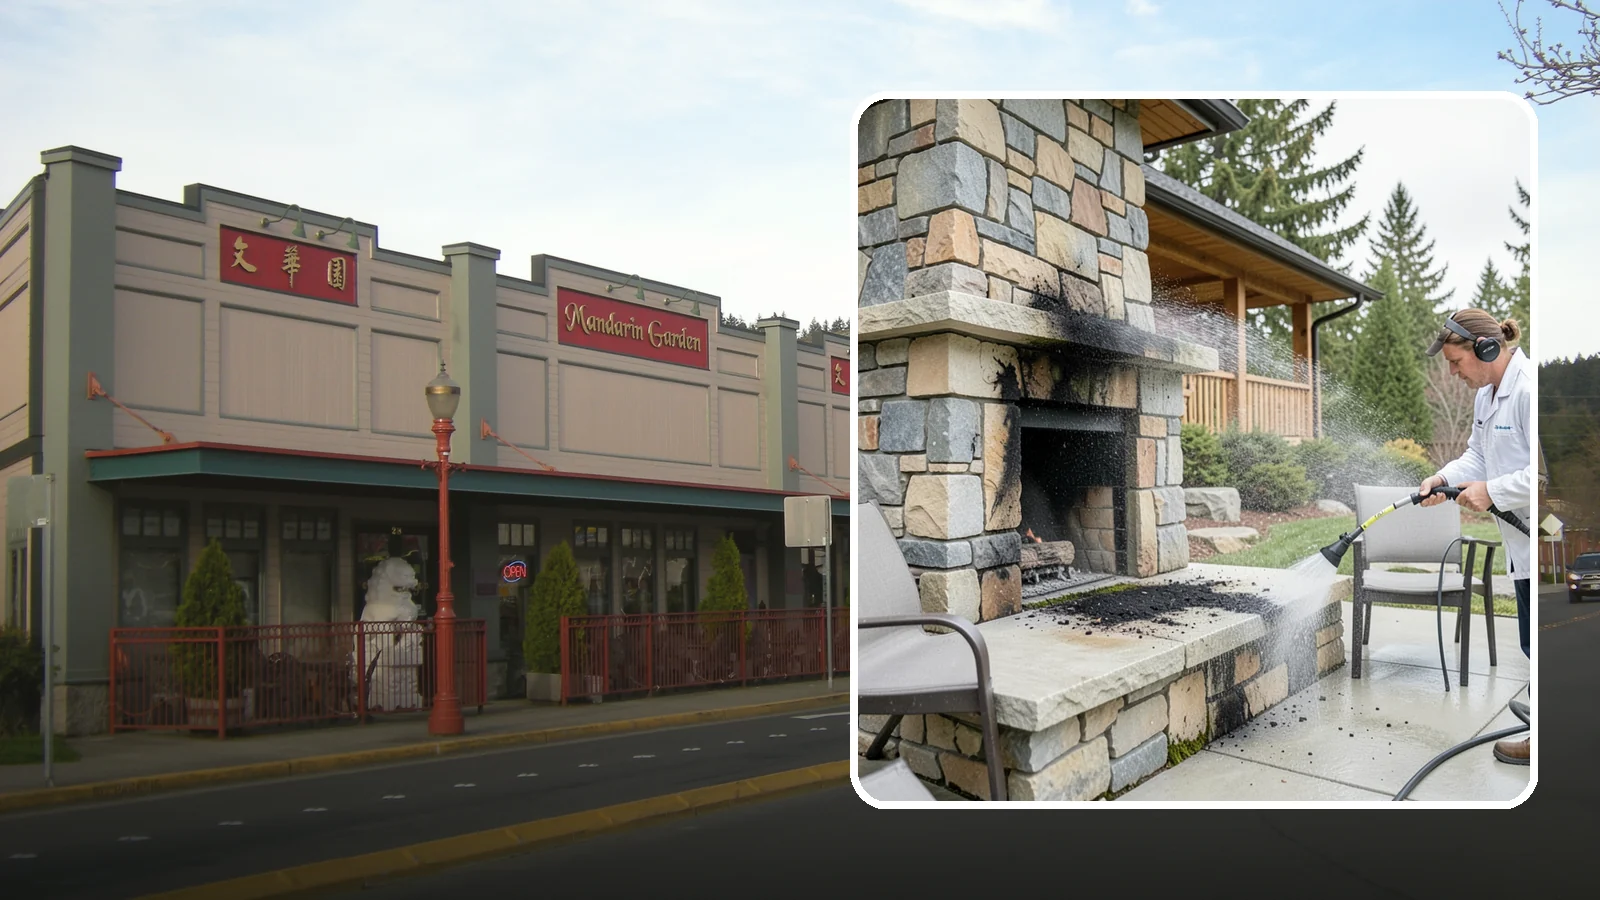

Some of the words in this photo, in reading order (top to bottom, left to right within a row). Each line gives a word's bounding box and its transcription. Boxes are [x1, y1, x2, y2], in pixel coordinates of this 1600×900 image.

[231, 236, 346, 290] 文華園
[565, 303, 644, 340] Mandarin
[648, 321, 701, 352] Garden
[503, 565, 527, 578] OPEN
